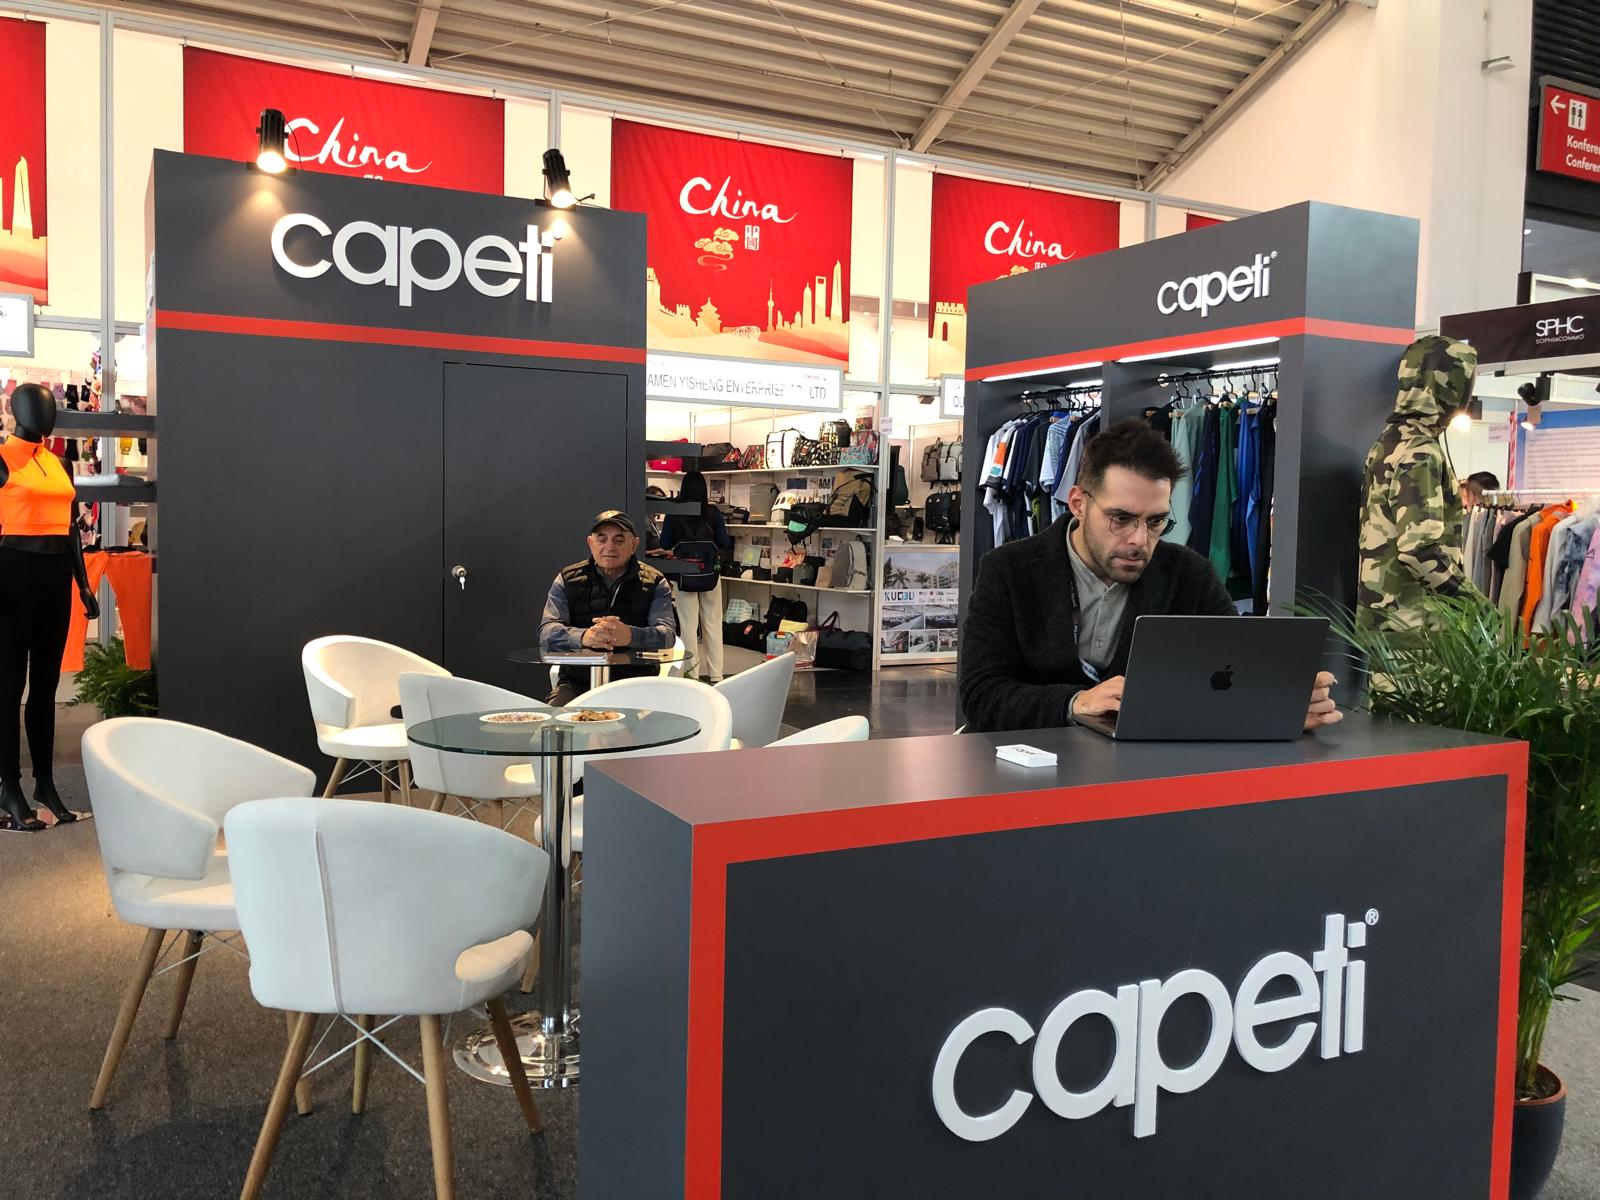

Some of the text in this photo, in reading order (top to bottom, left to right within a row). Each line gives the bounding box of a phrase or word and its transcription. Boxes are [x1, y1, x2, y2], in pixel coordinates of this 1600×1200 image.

[284, 117, 432, 173] China
[679, 176, 797, 223] China
[271, 213, 554, 306] capeti
[984, 219, 1077, 260] China
[1535, 315, 1584, 337] SPHC
